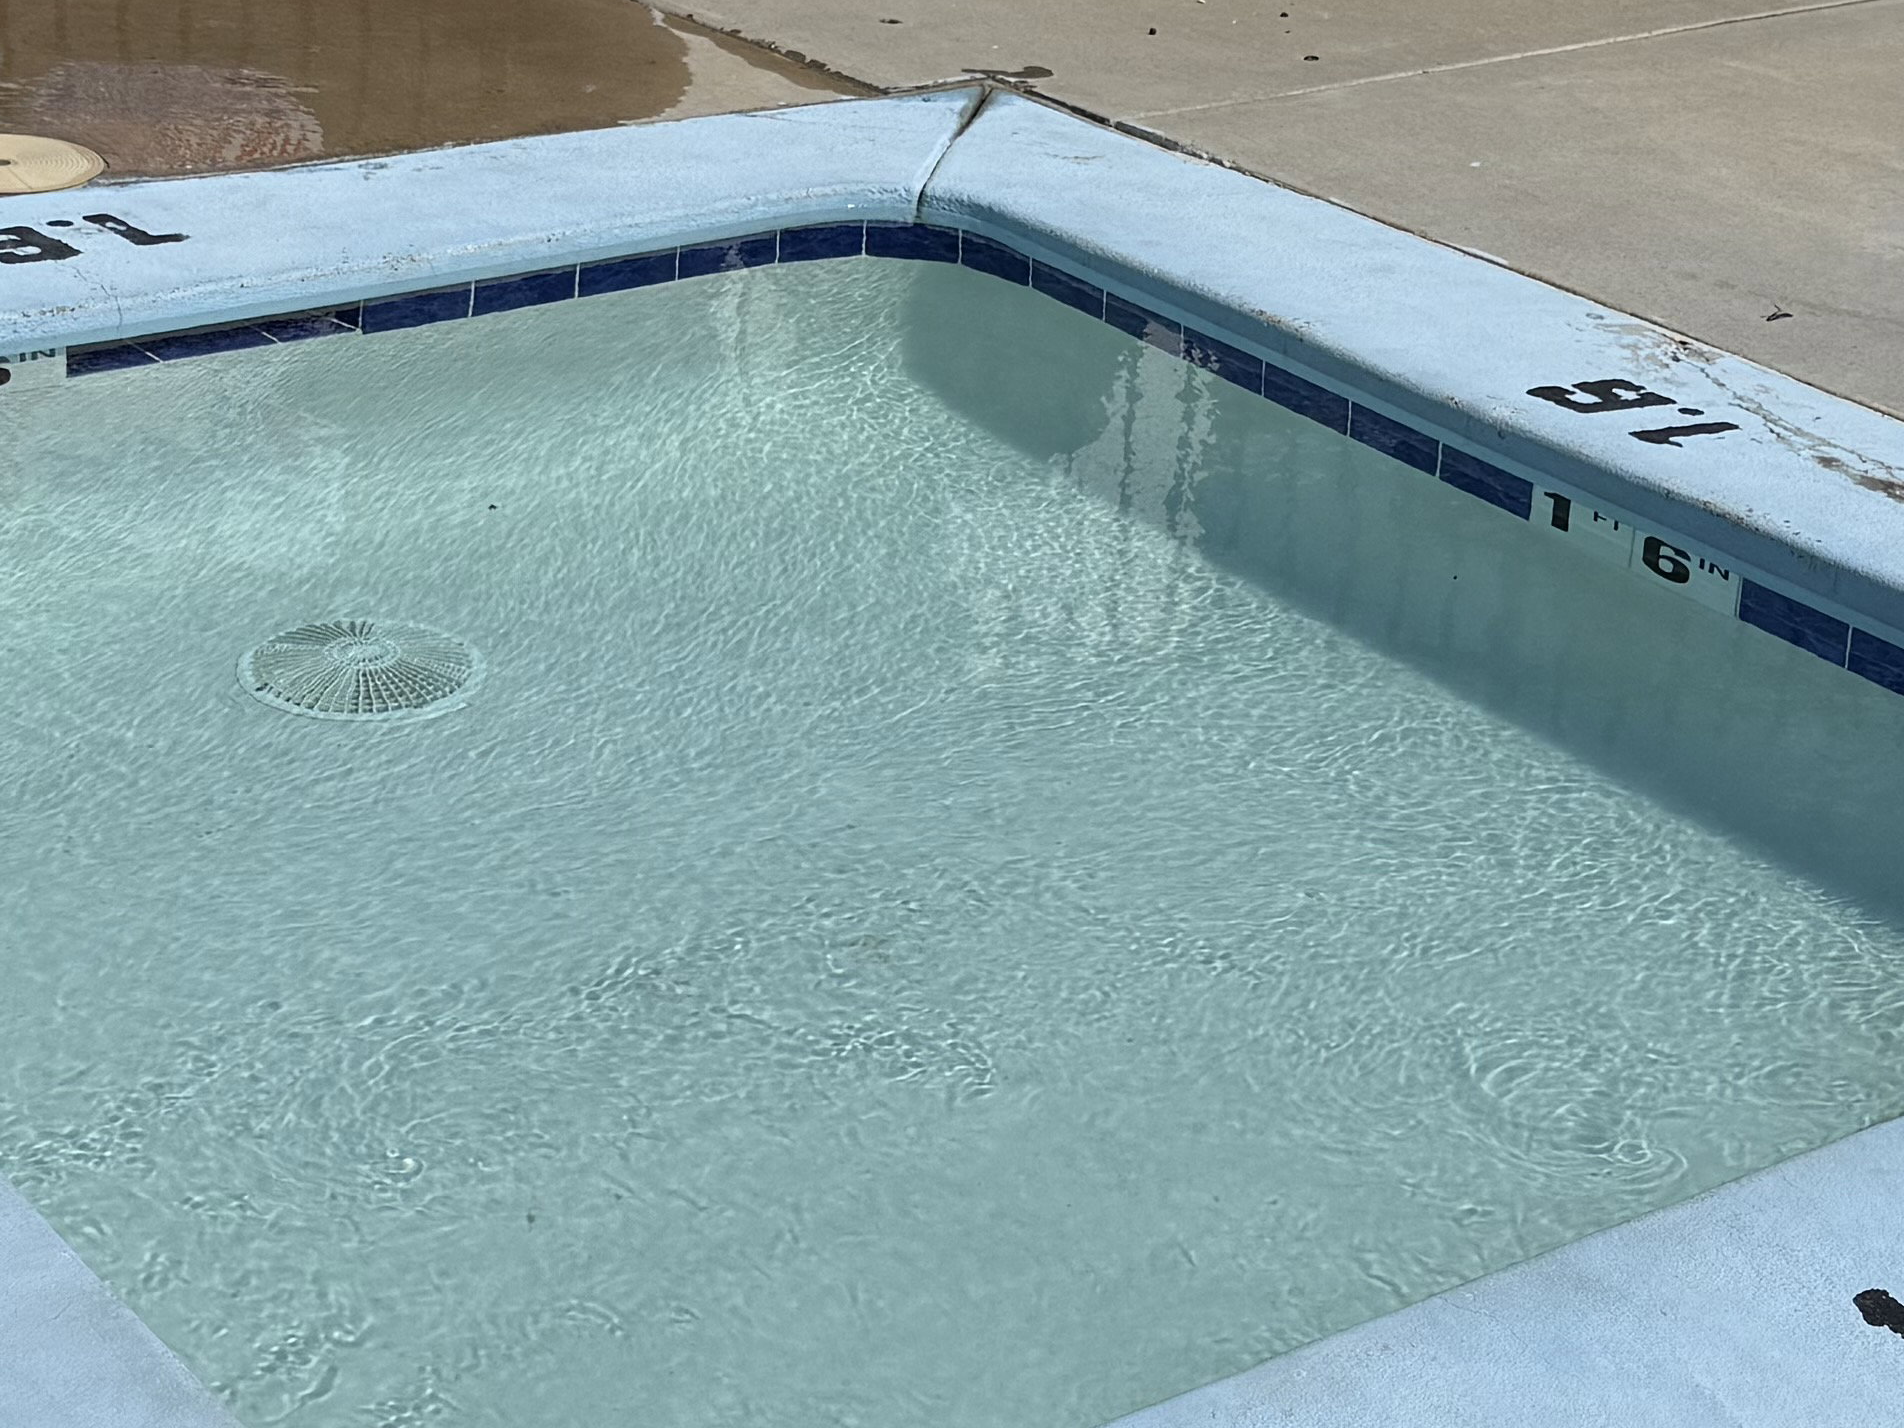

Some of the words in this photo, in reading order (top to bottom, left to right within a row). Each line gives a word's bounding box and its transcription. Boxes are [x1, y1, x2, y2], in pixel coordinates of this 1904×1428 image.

[1544, 492, 1571, 532] 1
[1642, 536, 1691, 584] 6
[1698, 558, 1730, 581] IN
